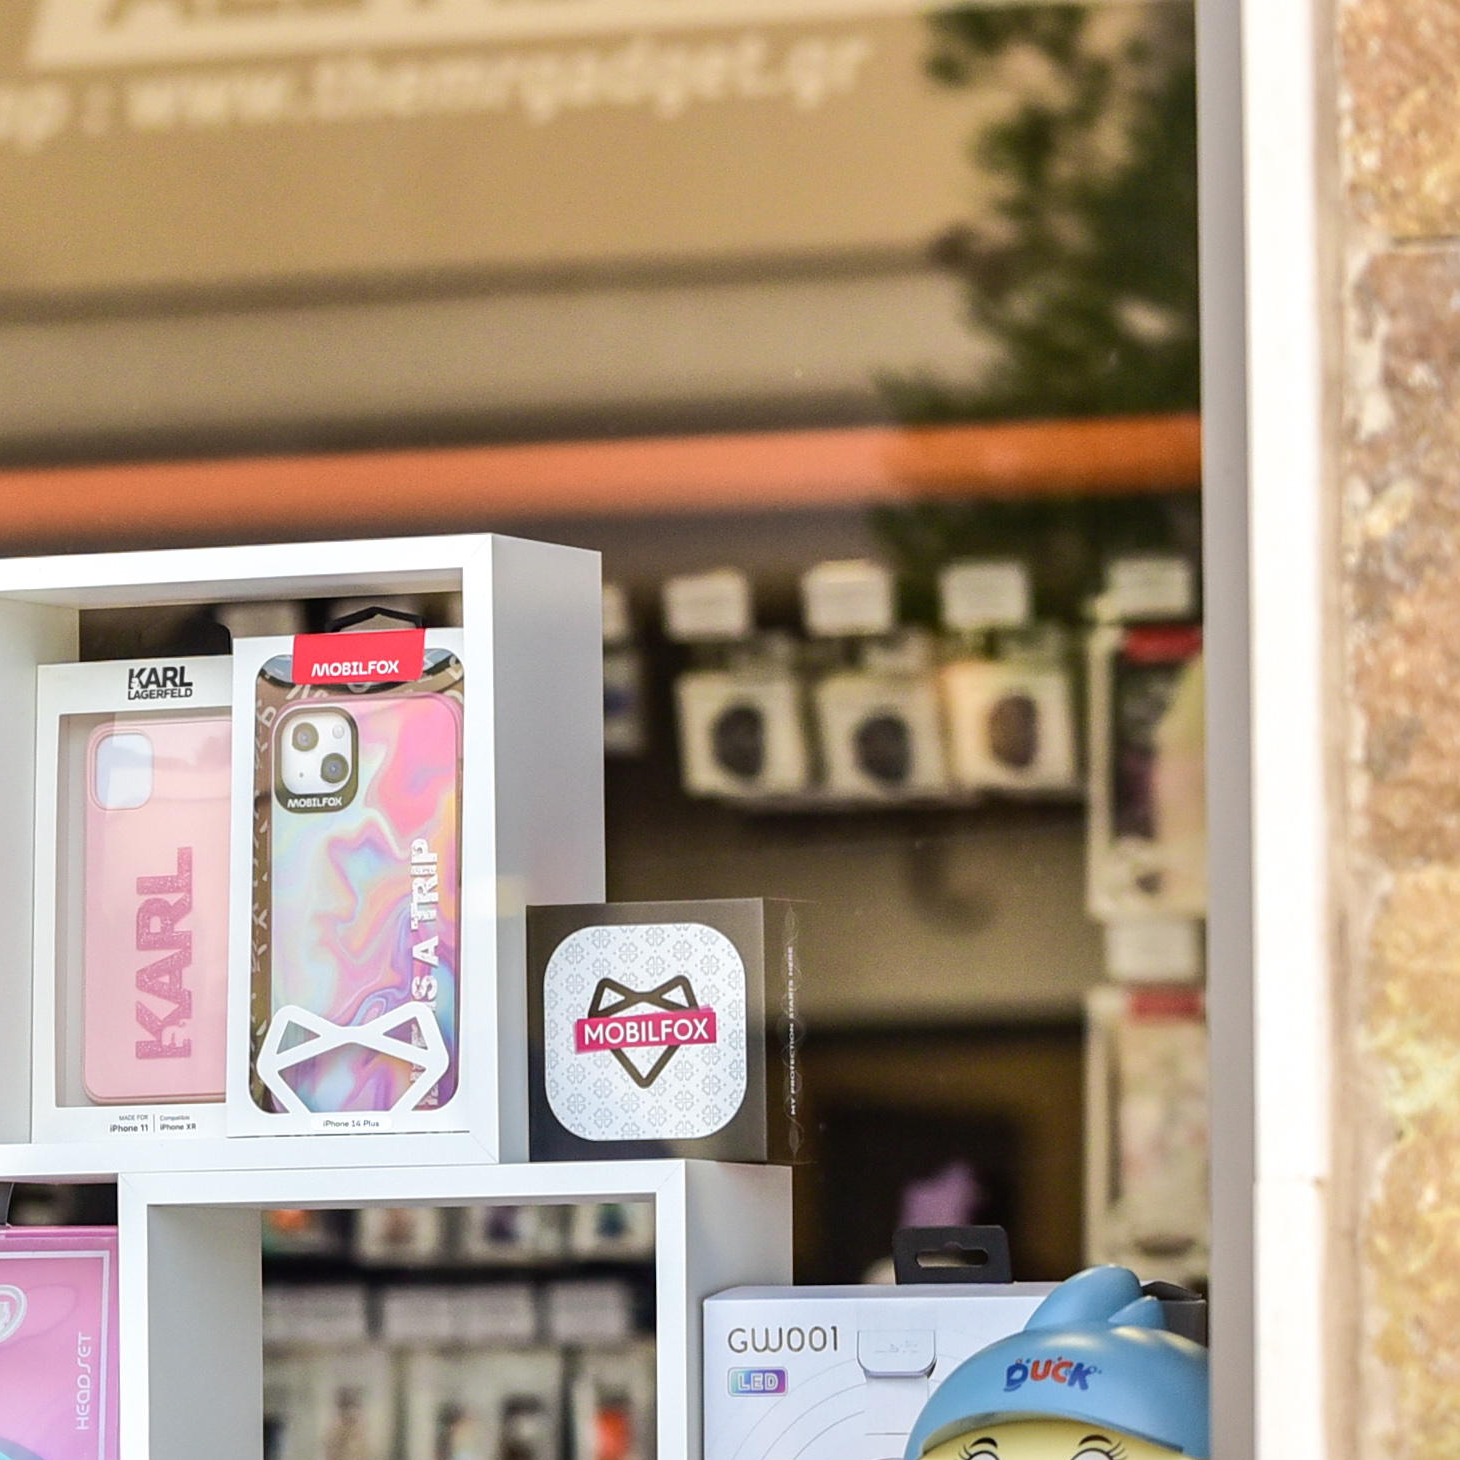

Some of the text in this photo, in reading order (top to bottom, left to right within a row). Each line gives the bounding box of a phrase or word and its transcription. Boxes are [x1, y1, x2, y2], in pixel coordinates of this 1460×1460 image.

[128, 666, 192, 690] KARL
[311, 660, 399, 677] MOBILFOX
[128, 687, 192, 701] LAGERFELD
[287, 797, 342, 808] MOBILFOX
[410, 838, 439, 930] TRIP
[135, 847, 192, 1059] KARL
[412, 934, 440, 968] A
[583, 1018, 709, 1045] MOBILFOX
[787, 946, 798, 1116] MY PROTECTION STARTS HERE
[109, 1122, 149, 1133] iPhone 11
[159, 1122, 197, 1131] iPhone XR
[322, 1119, 380, 1128] iPhone 14 Plus
[727, 1326, 839, 1354] GW001
[737, 1373, 778, 1391] LED
